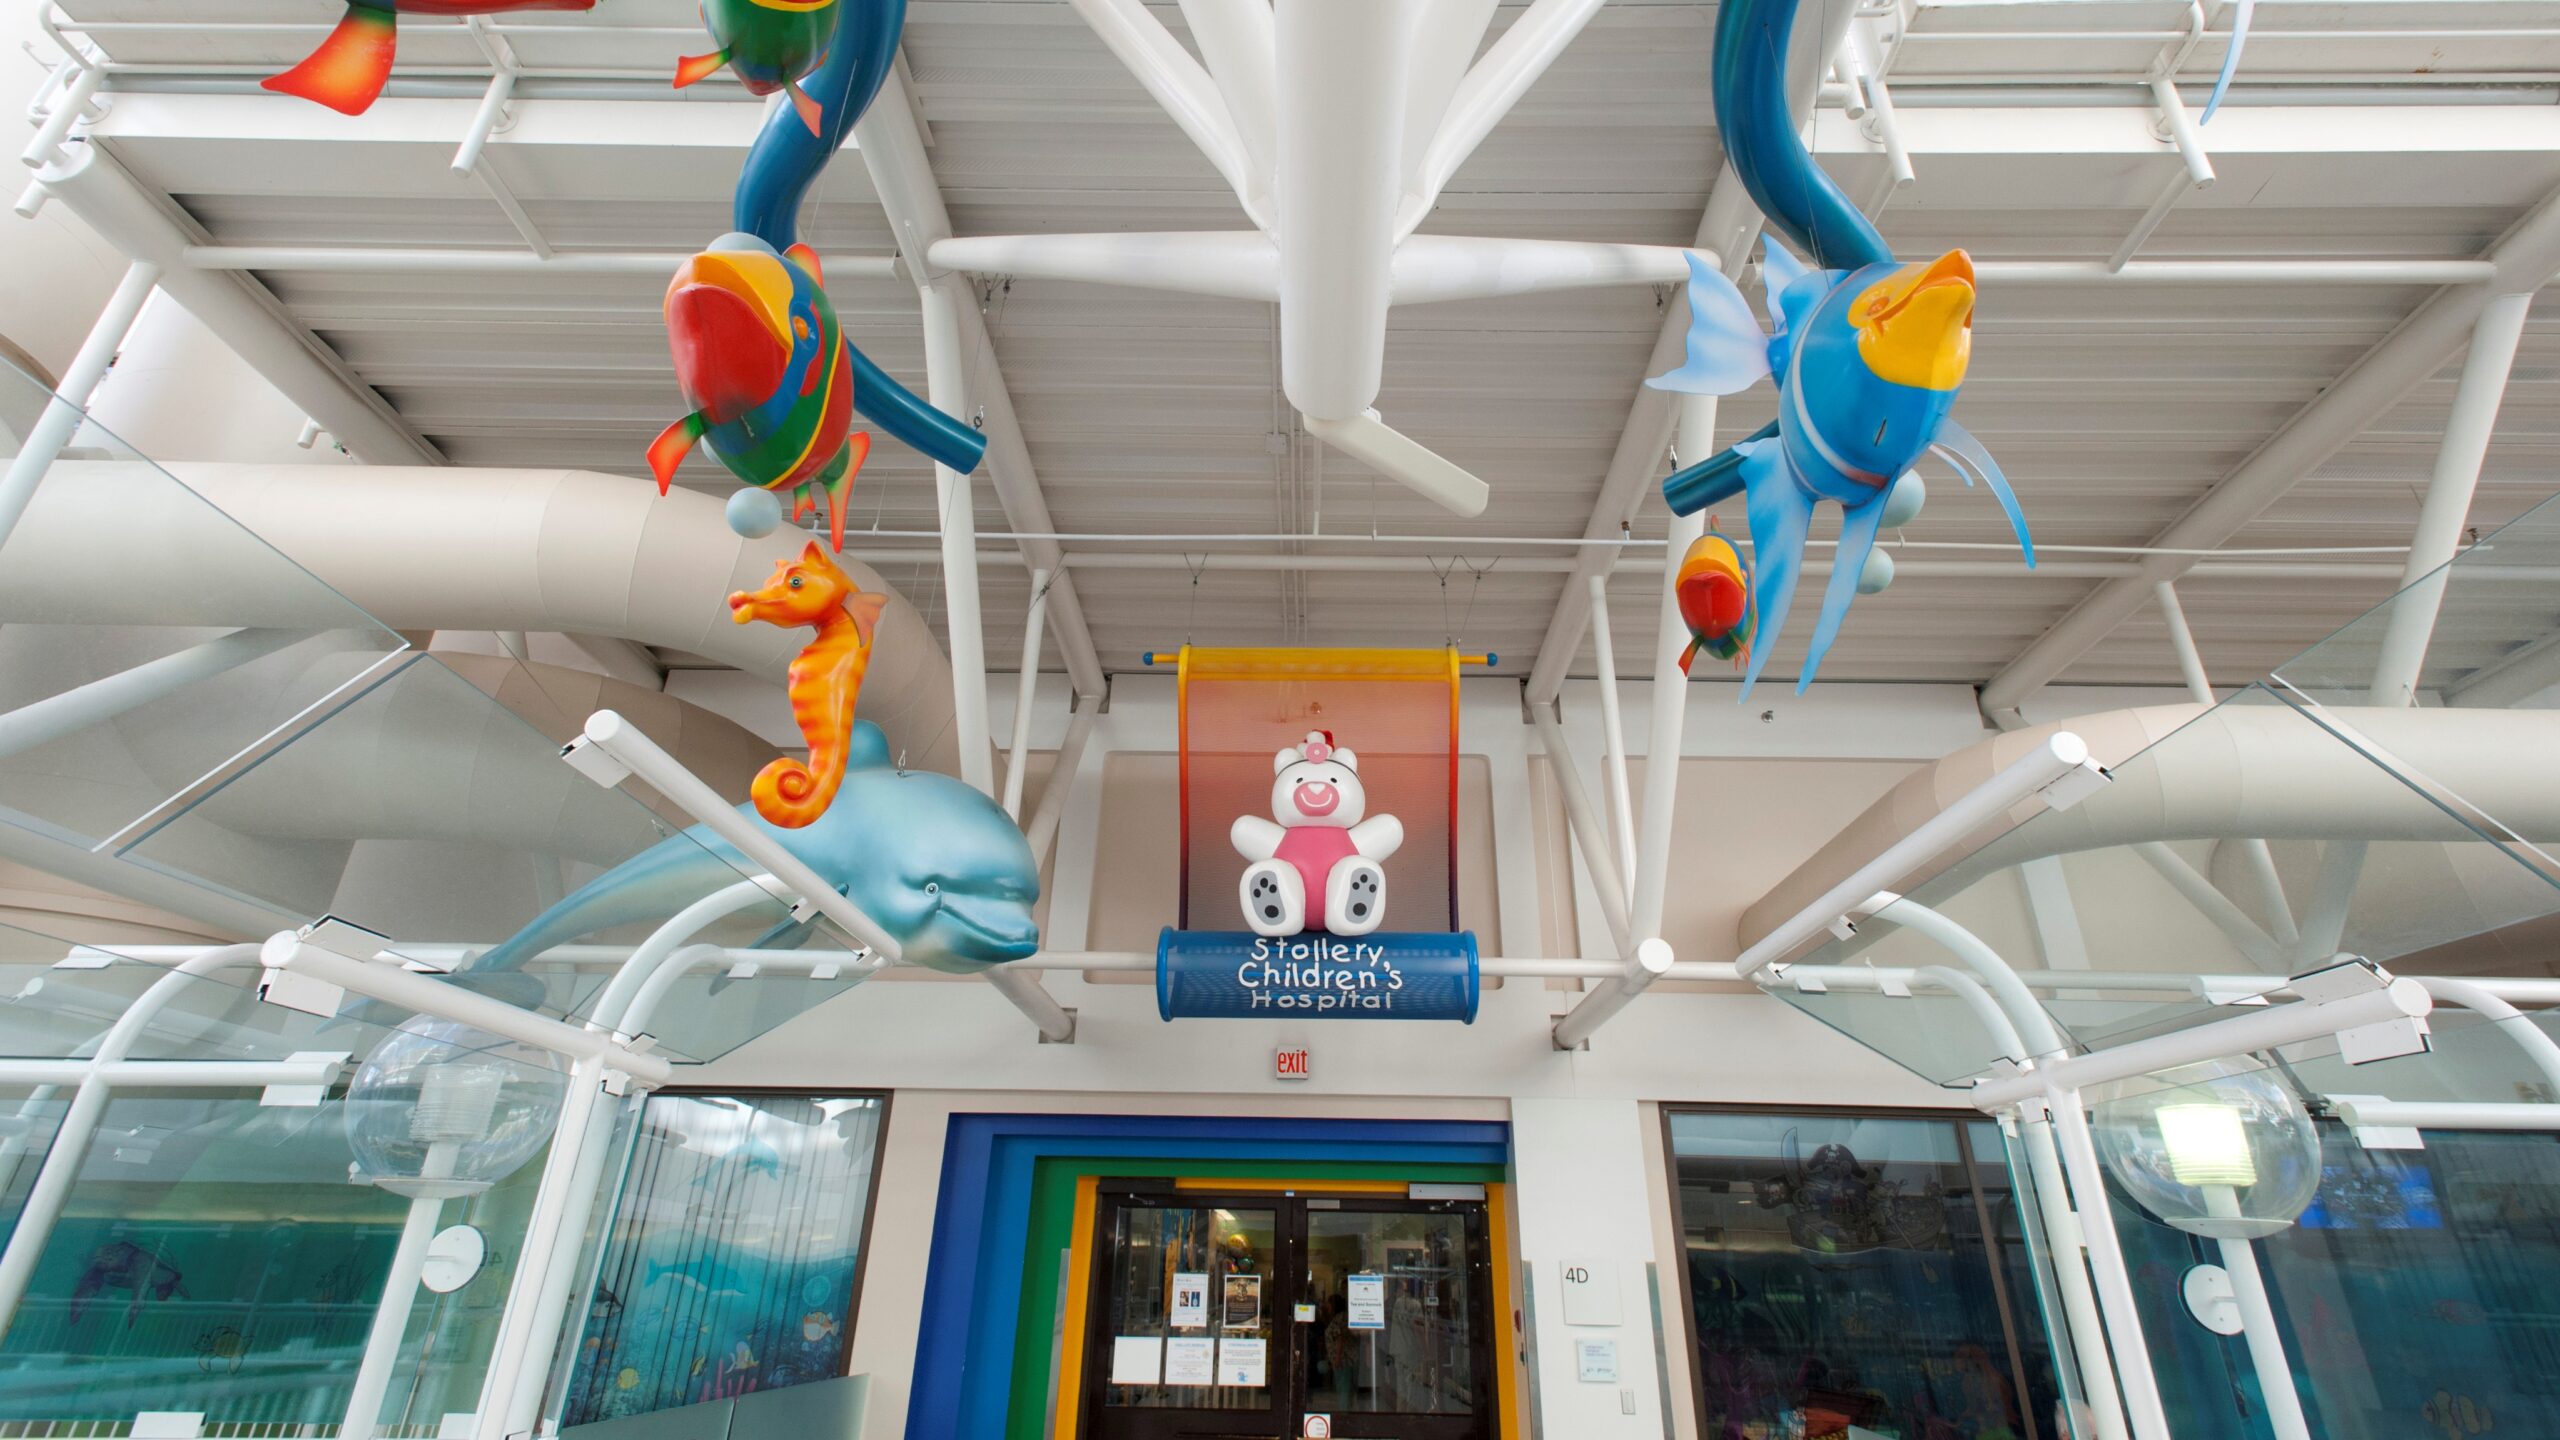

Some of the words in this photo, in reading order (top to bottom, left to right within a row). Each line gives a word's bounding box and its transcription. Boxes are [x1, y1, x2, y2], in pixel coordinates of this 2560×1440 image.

[1251, 937, 1384, 966] Stollery
[1238, 961, 1403, 990] Children's
[1251, 990, 1391, 1012] Hospital
[1277, 1050, 1308, 1073] exit
[1565, 1267, 1589, 1284] 4D
